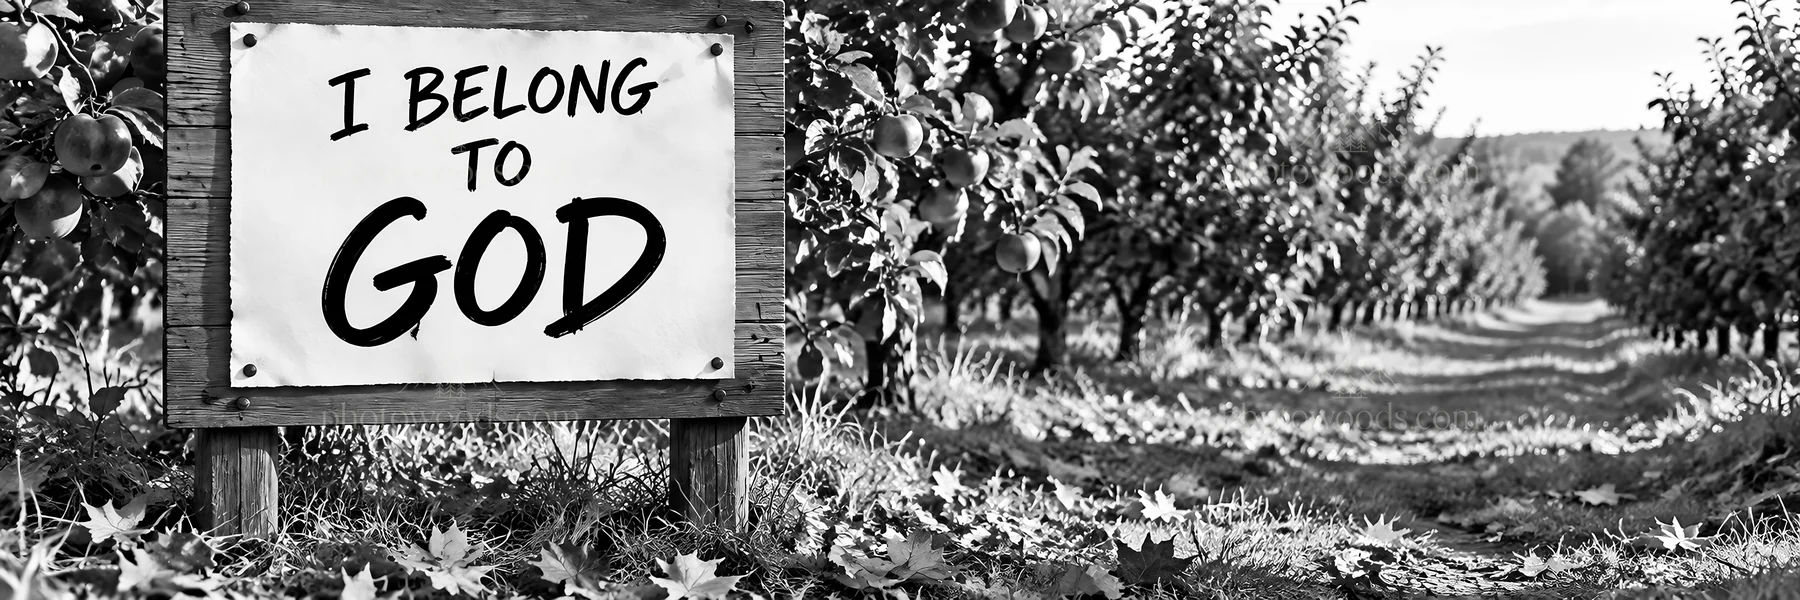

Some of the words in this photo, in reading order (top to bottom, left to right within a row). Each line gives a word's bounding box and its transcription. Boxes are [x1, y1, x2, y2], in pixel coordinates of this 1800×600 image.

[328, 67, 371, 142] I
[404, 57, 659, 133] BELONG
[450, 137, 532, 193] TO
[321, 196, 667, 348] GOD
